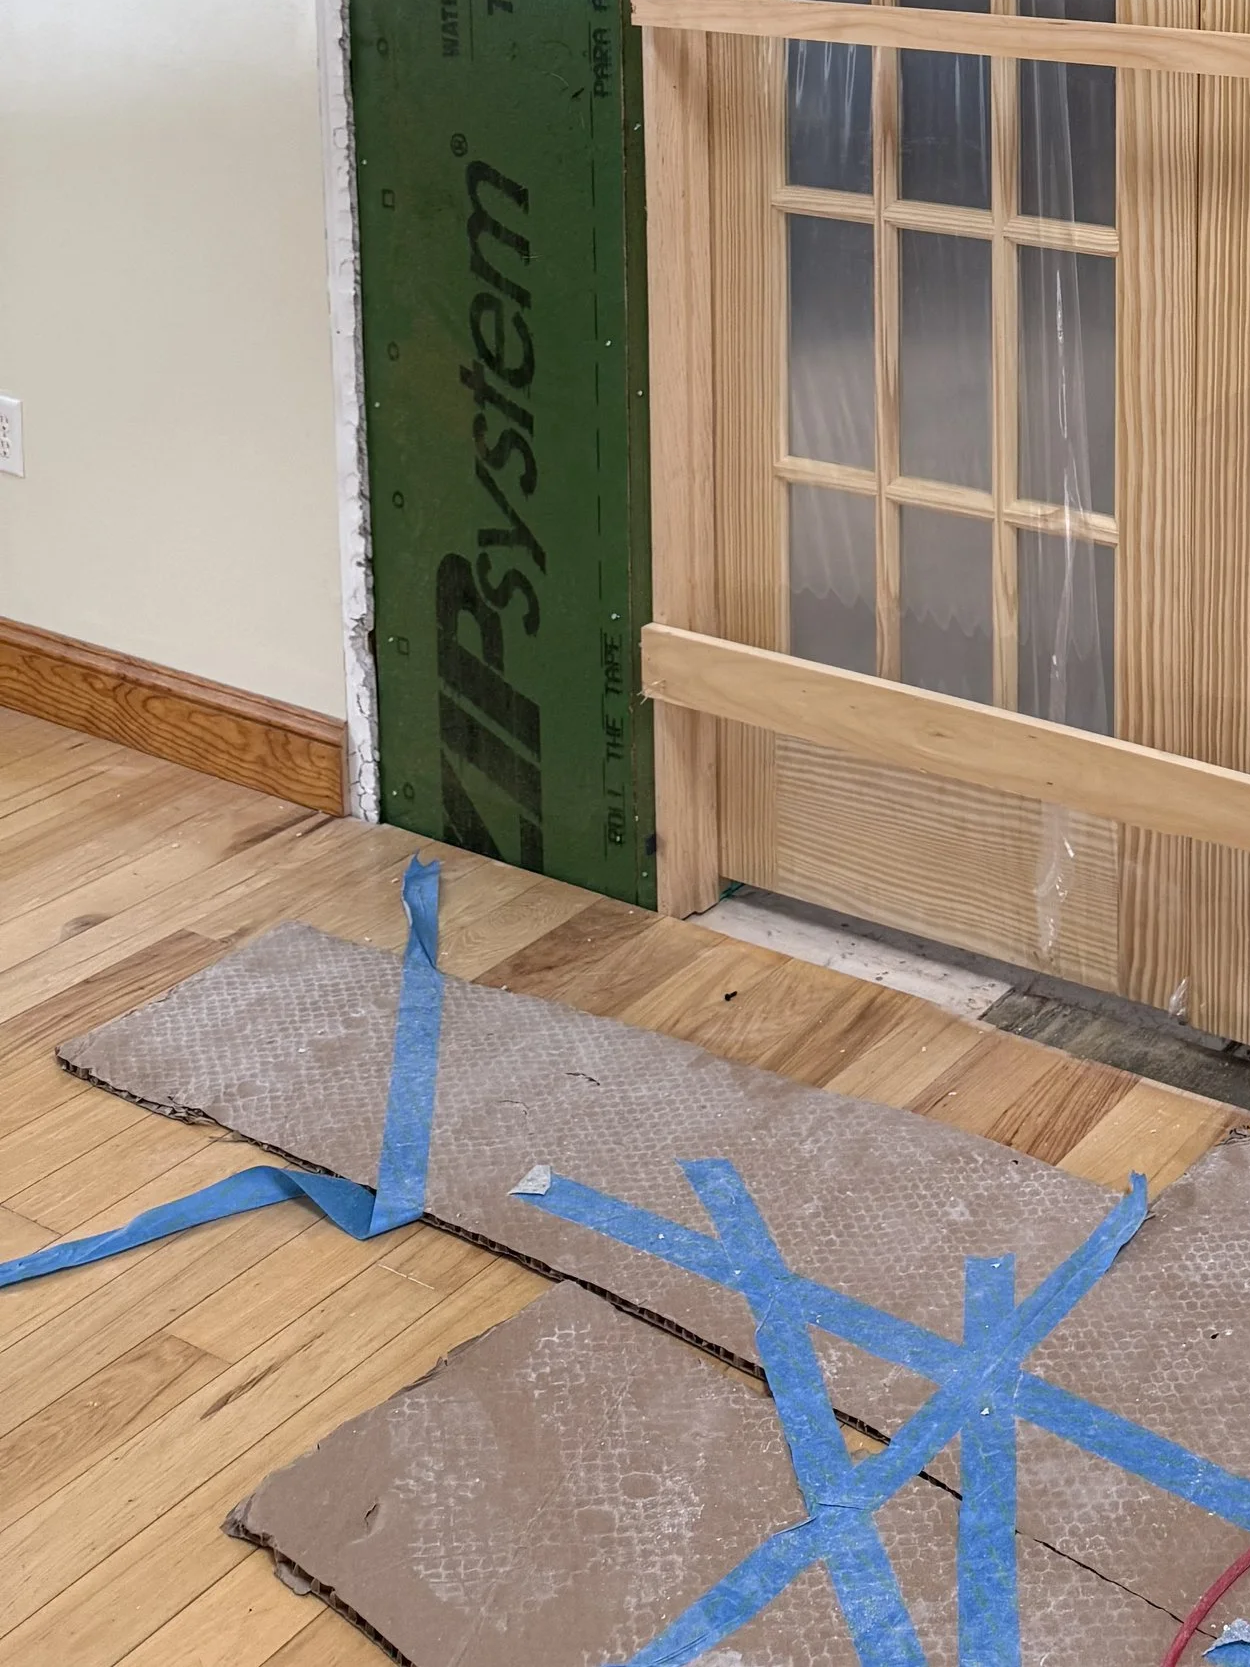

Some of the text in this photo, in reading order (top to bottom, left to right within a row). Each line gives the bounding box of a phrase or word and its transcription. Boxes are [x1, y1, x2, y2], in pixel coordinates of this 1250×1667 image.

[587, 27, 612, 99] PARA
[603, 634, 626, 846] ROLL THE TAPE
